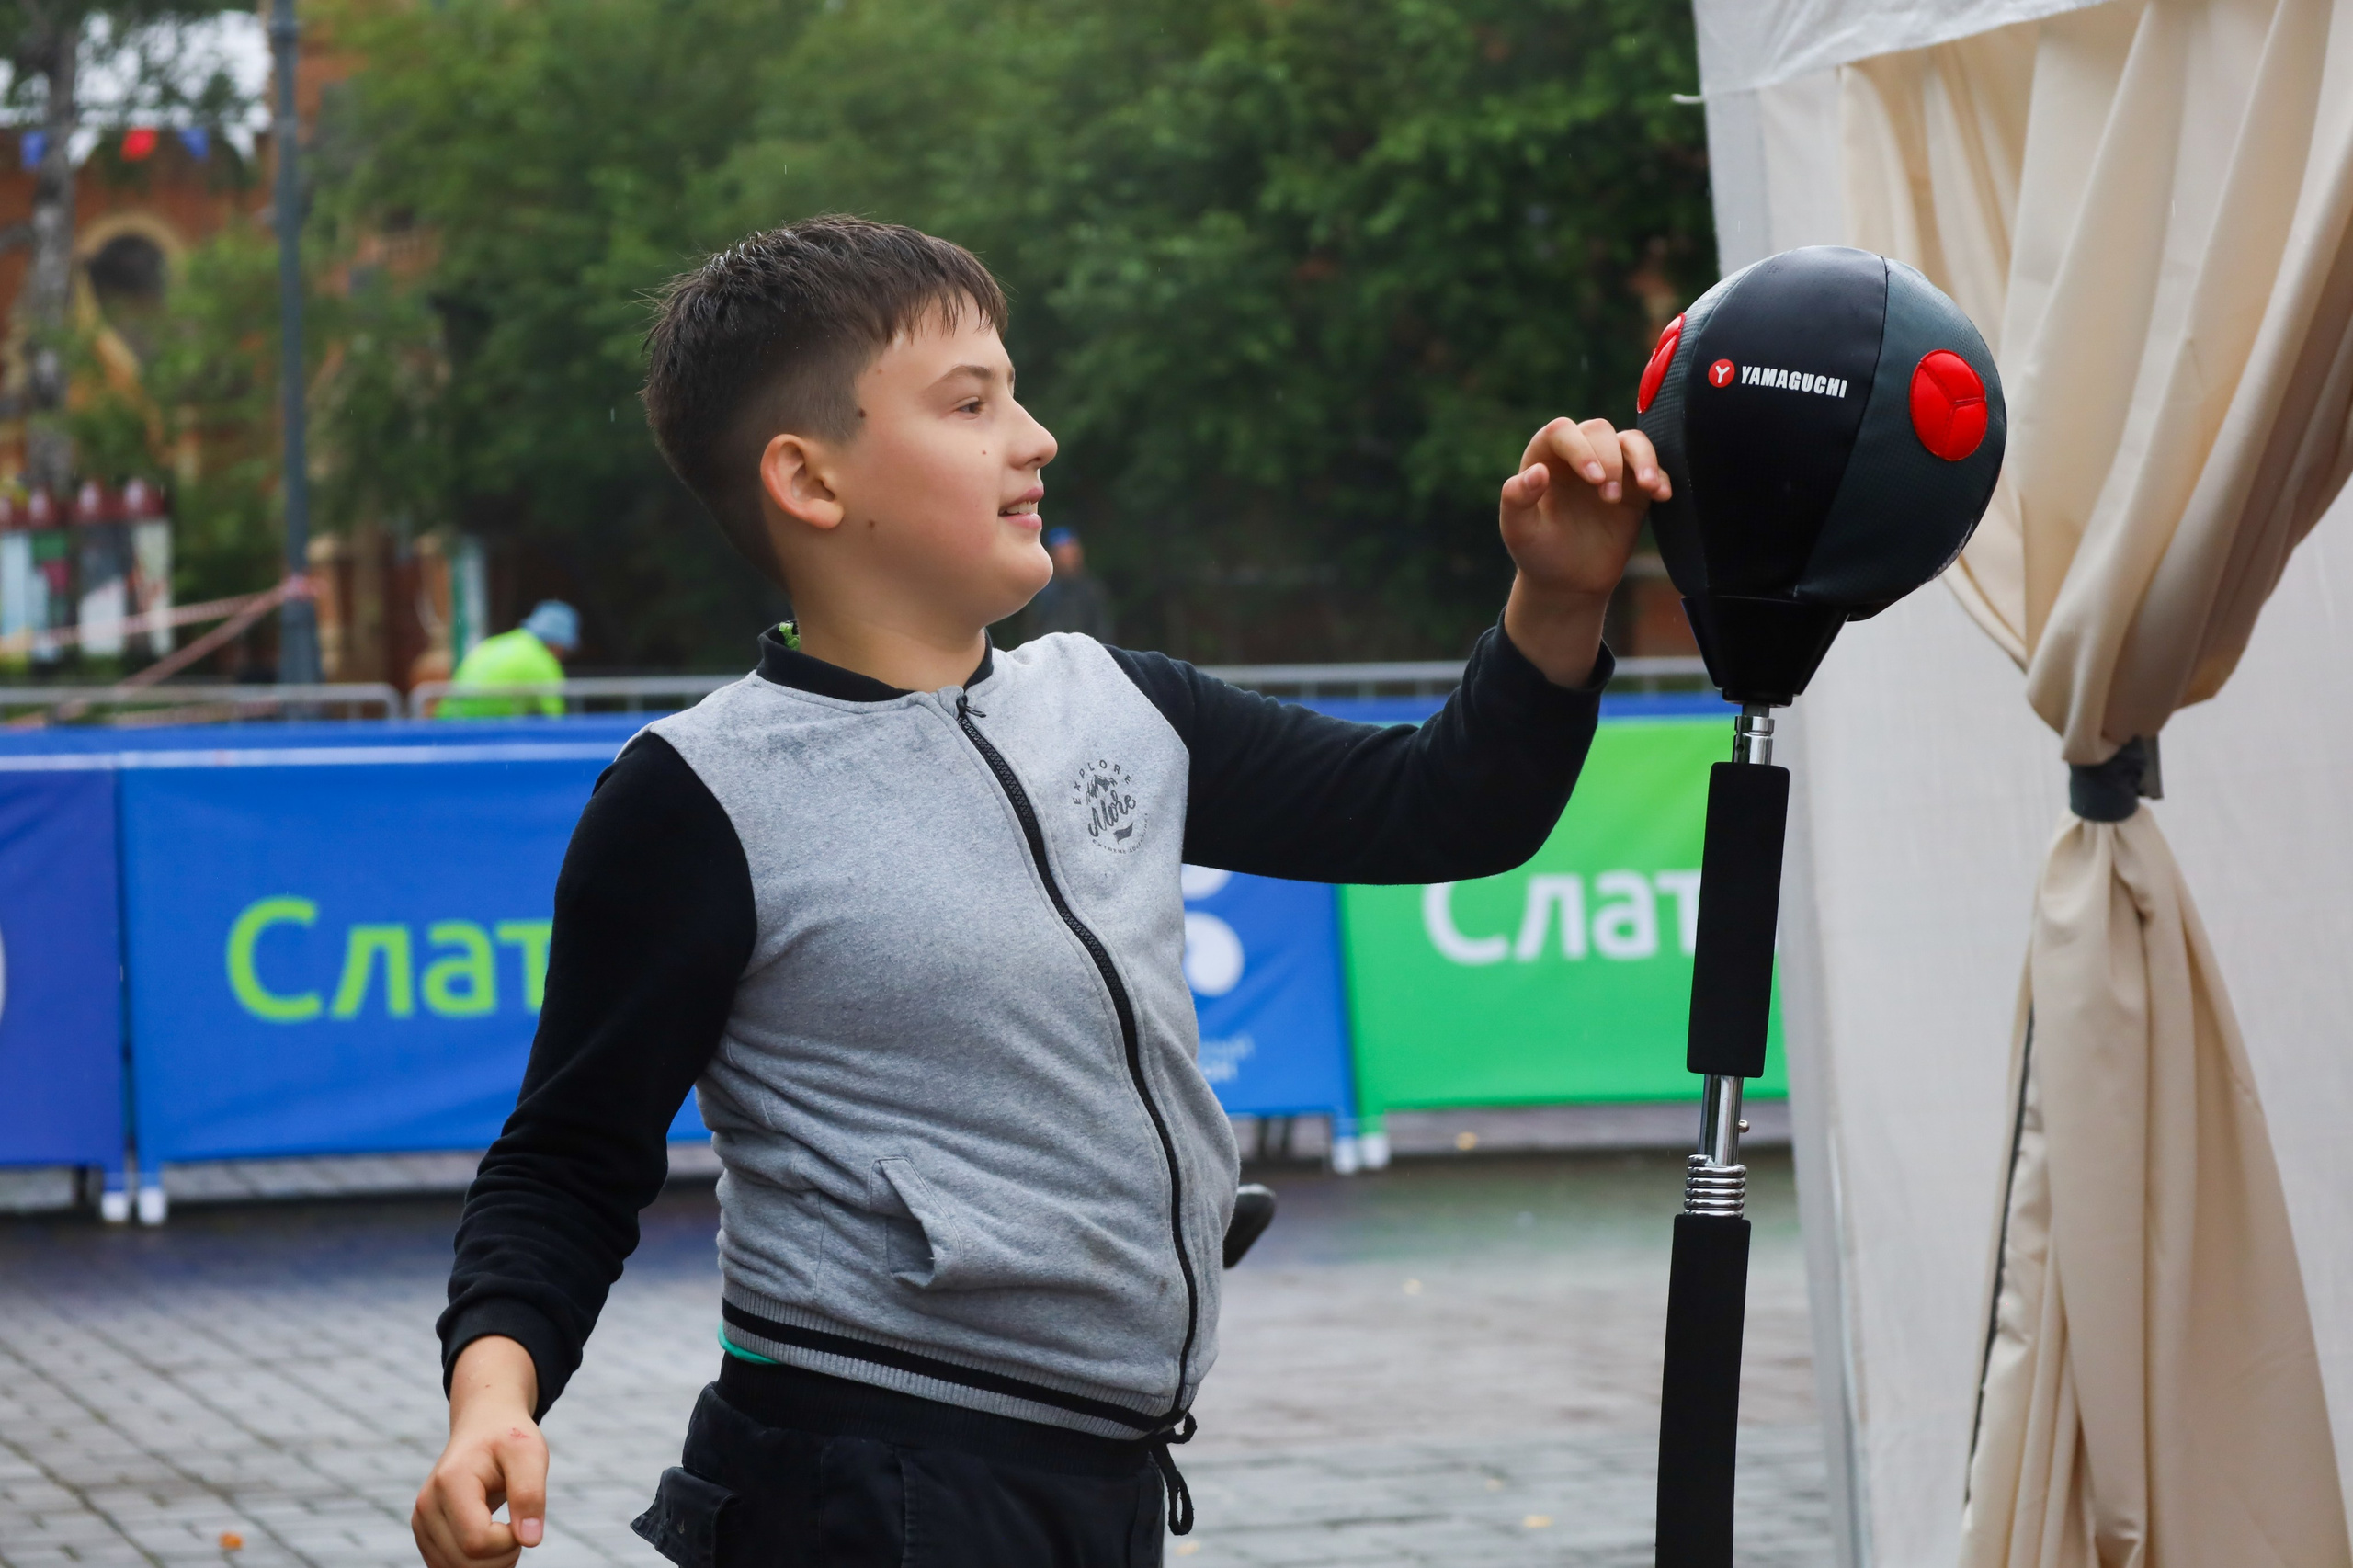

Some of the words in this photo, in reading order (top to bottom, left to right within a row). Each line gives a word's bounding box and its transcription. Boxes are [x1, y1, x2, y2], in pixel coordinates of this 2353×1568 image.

[1741, 366, 1848, 399] YAMAGUCHI
[1072, 759, 1132, 805] EXPLORE
[1087, 790, 1137, 838] More
[1421, 869, 1702, 966] Слат
[225, 893, 553, 1024] Слат
